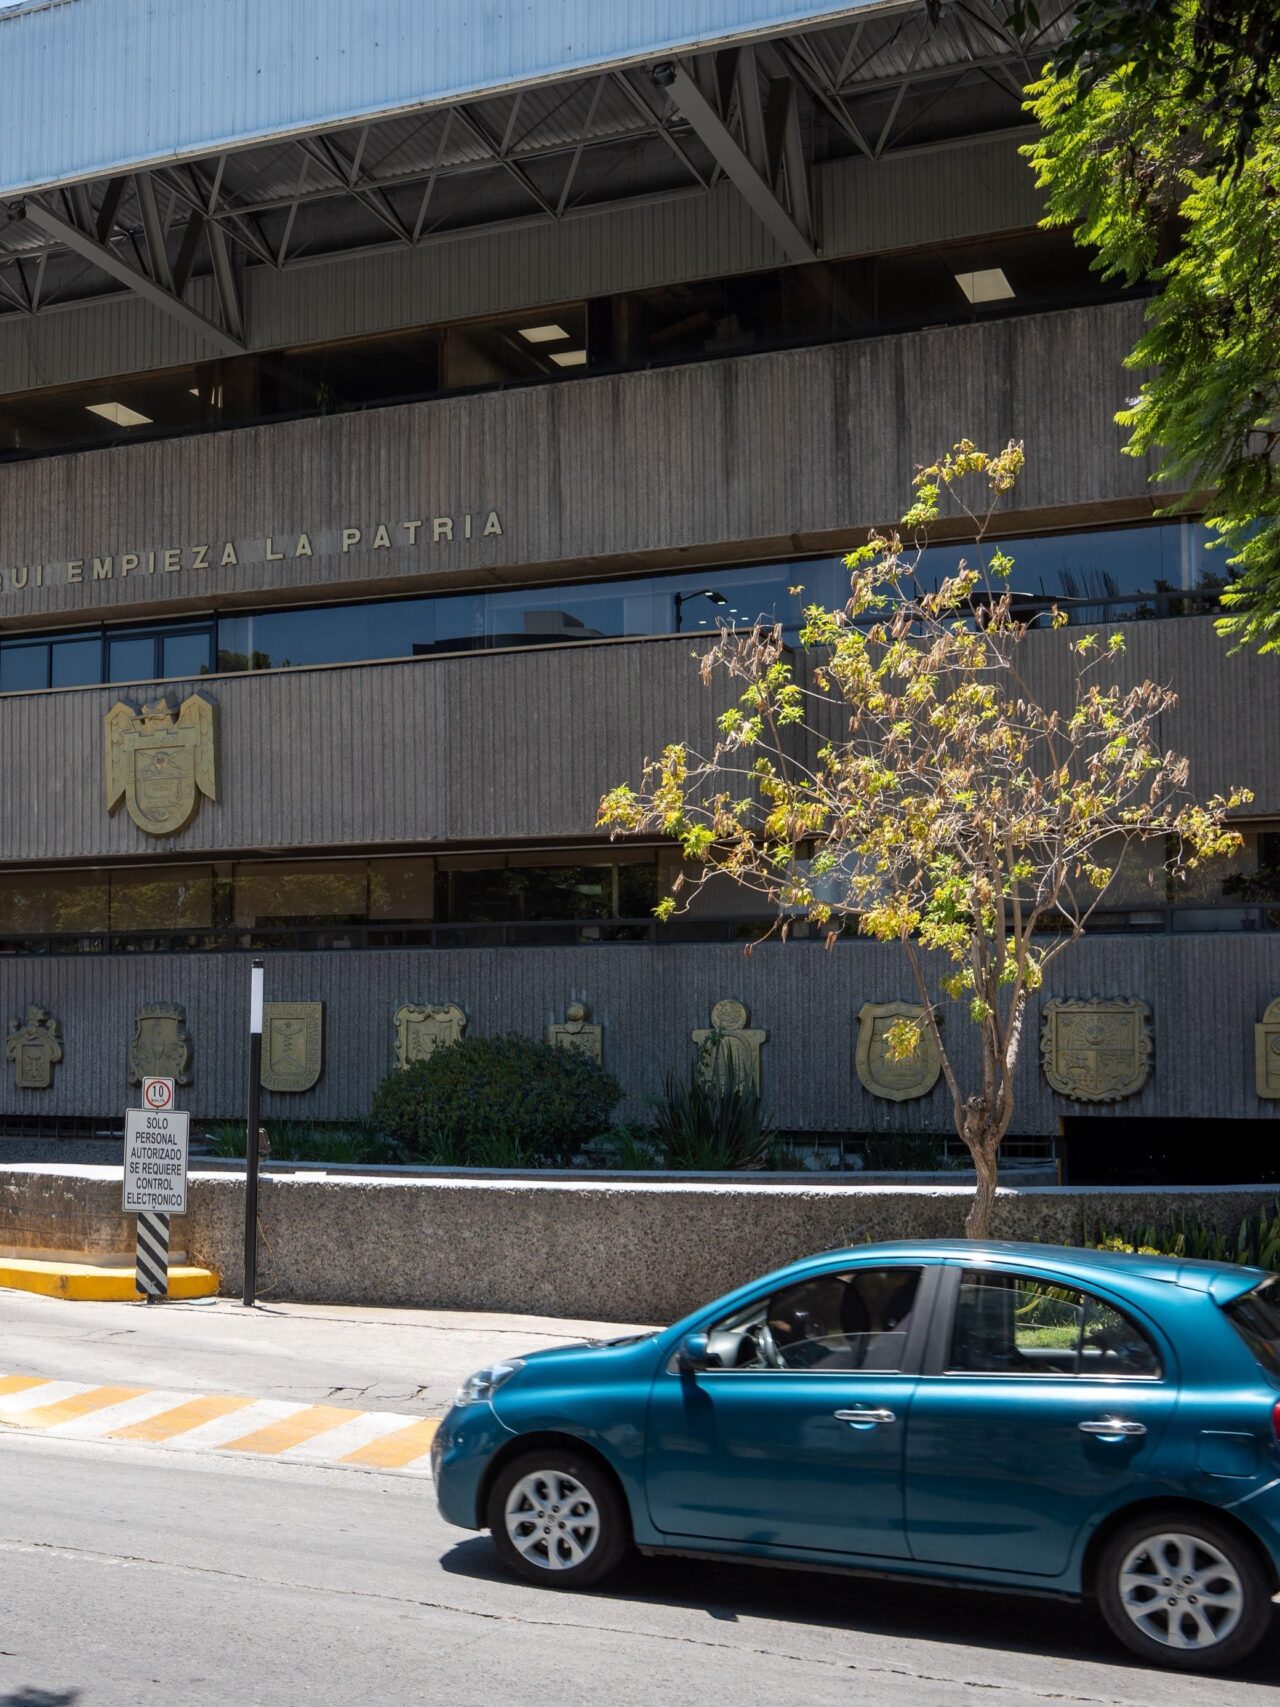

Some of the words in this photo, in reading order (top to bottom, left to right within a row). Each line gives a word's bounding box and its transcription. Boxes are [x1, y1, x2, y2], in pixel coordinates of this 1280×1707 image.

[66, 541, 238, 584] EMPIEZA
[264, 533, 313, 561] LA
[342, 511, 504, 554] PATRIA
[152, 1085, 164, 1098] 10
[146, 1117, 169, 1130] SOLO
[135, 1131, 178, 1146] PERSONAL
[130, 1147, 182, 1161] AUTORIZADO
[129, 1161, 140, 1174] SE
[142, 1162, 182, 1176] REQUIERE
[136, 1177, 174, 1191] CONTROL
[126, 1192, 183, 1206] ELECTRONICO
